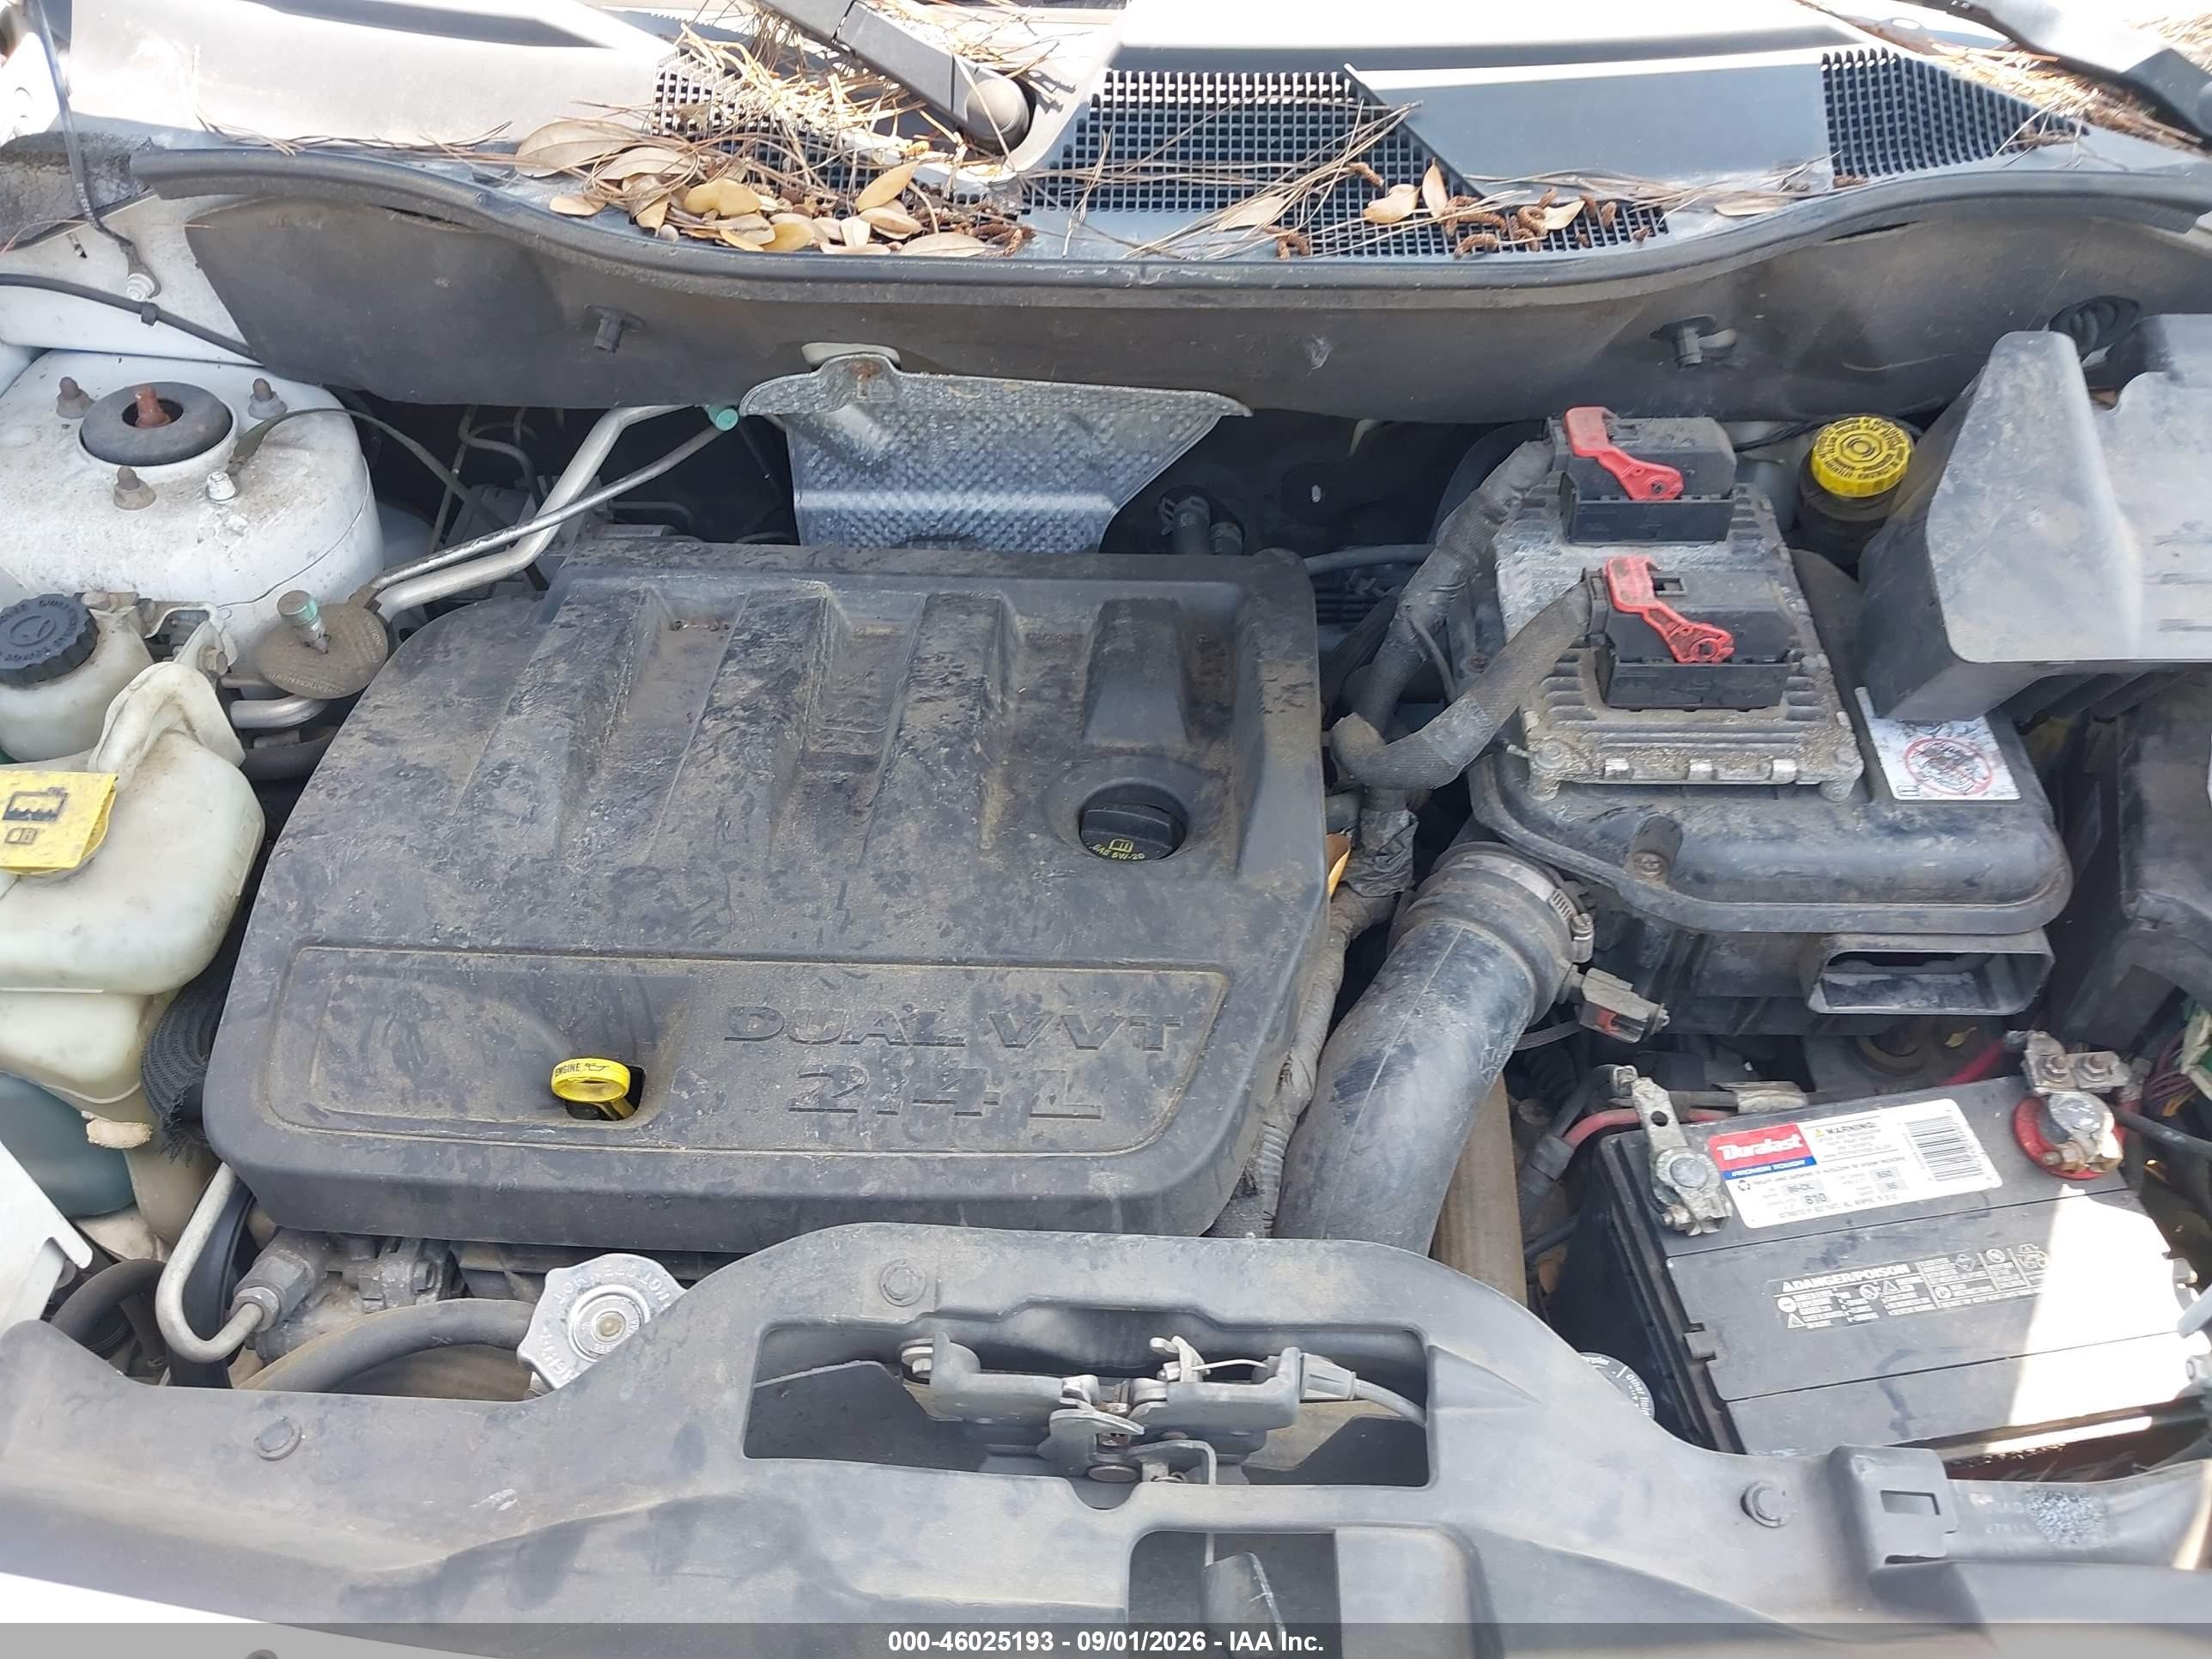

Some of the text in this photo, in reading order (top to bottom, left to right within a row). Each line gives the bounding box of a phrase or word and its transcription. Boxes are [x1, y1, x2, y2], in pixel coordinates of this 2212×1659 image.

[724, 1005, 1182, 1051] DUAL VVT
[554, 1063, 581, 1077] ENGINE
[788, 1063, 1103, 1120] 2.4L
[1717, 1133, 1802, 1160] Duralast
